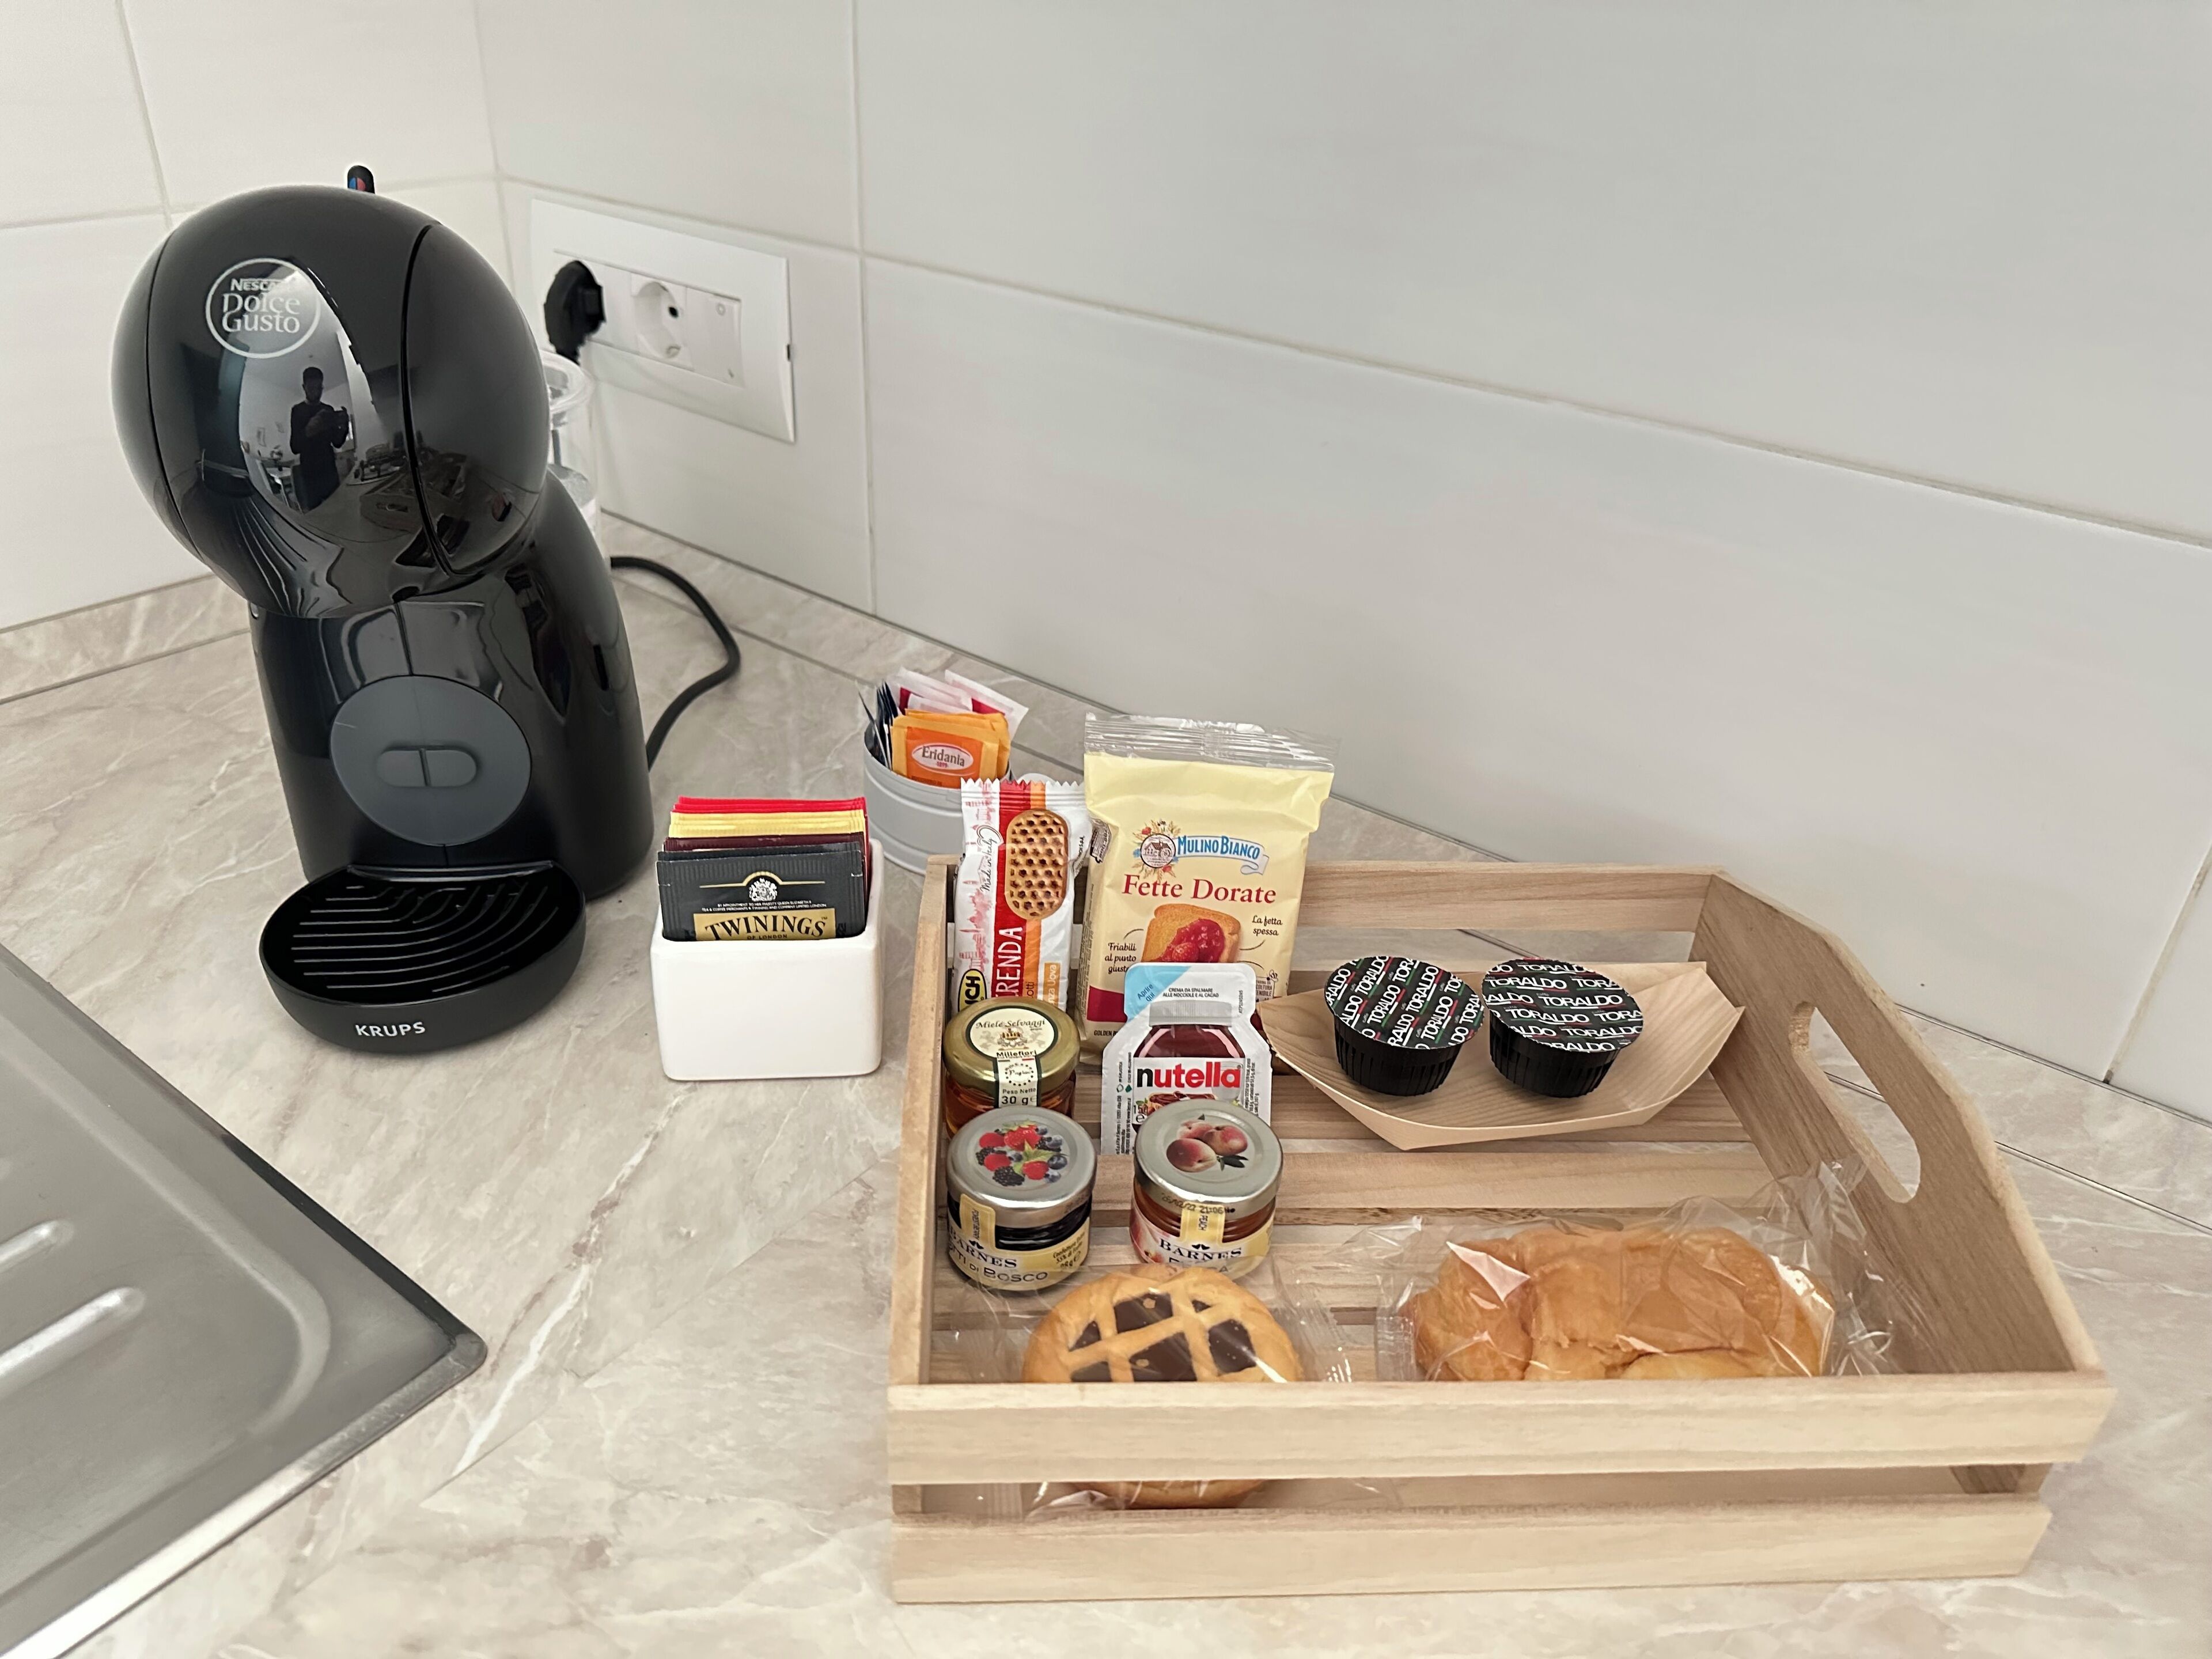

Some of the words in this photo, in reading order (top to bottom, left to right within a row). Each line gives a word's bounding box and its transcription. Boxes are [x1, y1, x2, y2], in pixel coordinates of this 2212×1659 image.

[222, 292, 301, 315] Dolce
[222, 310, 300, 334] Gusto
[922, 746, 965, 767] Eridania
[1177, 835, 1219, 855] MULINO
[1220, 835, 1260, 859] BIANCO
[980, 869, 991, 892] Made
[1122, 874, 1183, 897] Fette
[1191, 878, 1276, 903] Dorate
[705, 915, 825, 940] TWININGS
[1252, 915, 1263, 924] La
[1263, 916, 1282, 927] fetta
[1253, 928, 1279, 936] spessa
[1108, 942, 1137, 951] Friabili
[995, 927, 1022, 997] RENDA
[1105, 953, 1113, 961] al
[1114, 955, 1137, 967] punto
[1108, 966, 1128, 974] giust
[964, 976, 980, 1005] ICH
[1026, 982, 1035, 997] otti
[1138, 984, 1154, 1000] Aprire
[1406, 966, 1439, 1012] TORALDO
[1484, 977, 1567, 989] TORALDO
[1146, 993, 1155, 1002] qui
[1367, 985, 1400, 1024] TORALDO
[1486, 992, 1533, 1003] ALDO
[1537, 995, 1623, 1006] TORALDO
[1339, 995, 1363, 1027] ALDO
[1421, 996, 1453, 1040] TORALDO
[1505, 1009, 1590, 1022] TORALDO
[1594, 1010, 1642, 1022] TORA
[355, 1021, 425, 1037] KRUPS
[1387, 1014, 1415, 1047] RALDO
[1137, 1061, 1241, 1088] nutella
[1002, 1096, 1017, 1104] 30
[1022, 1097, 1028, 1105] g
[950, 1226, 1017, 1268] BARNES
[1160, 1238, 1241, 1260] BARNES
[984, 1267, 1048, 1282] BOSCO
